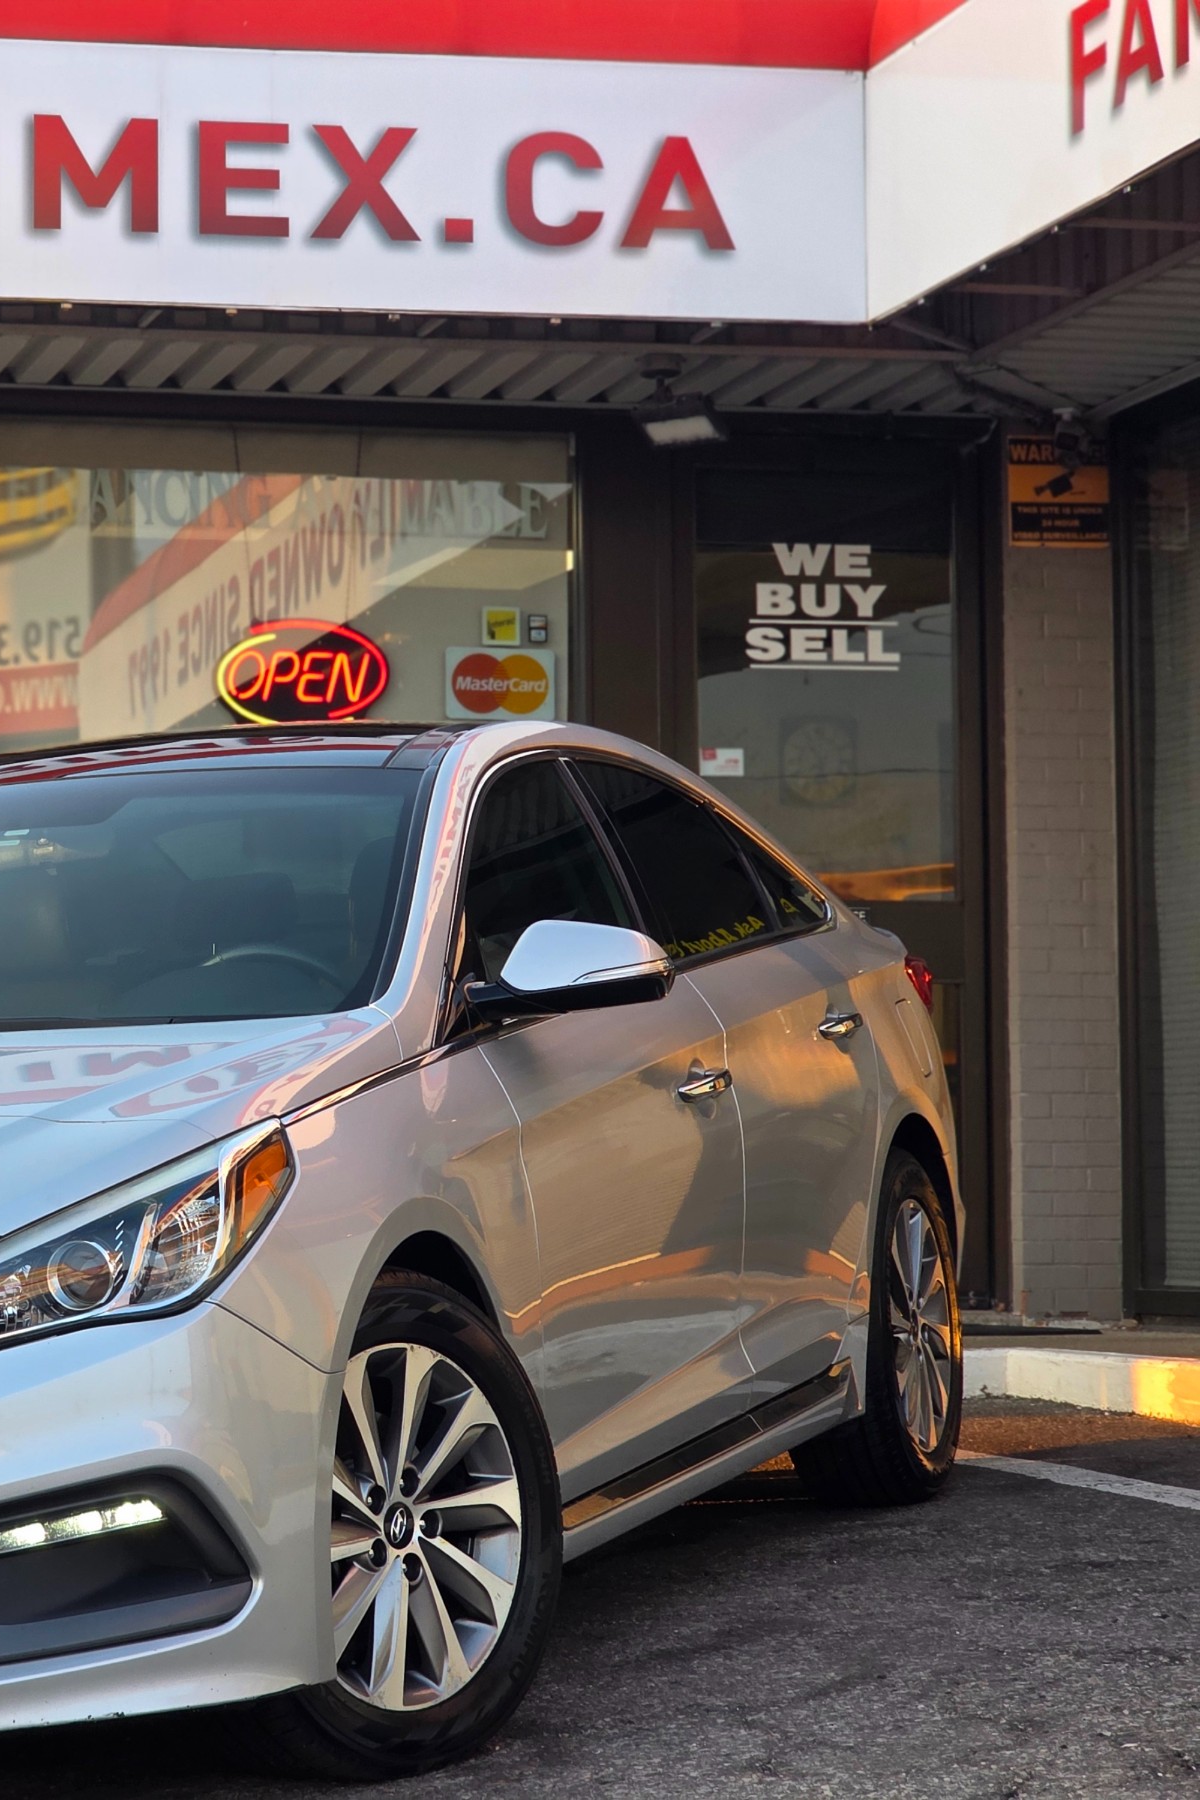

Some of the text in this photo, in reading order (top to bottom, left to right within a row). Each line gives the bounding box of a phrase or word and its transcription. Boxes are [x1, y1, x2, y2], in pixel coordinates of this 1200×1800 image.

[772, 543, 872, 577] WE
[756, 583, 887, 618] BUY
[745, 627, 901, 662] SELL
[225, 648, 371, 704] OPEN
[455, 676, 547, 693] MasterCard
